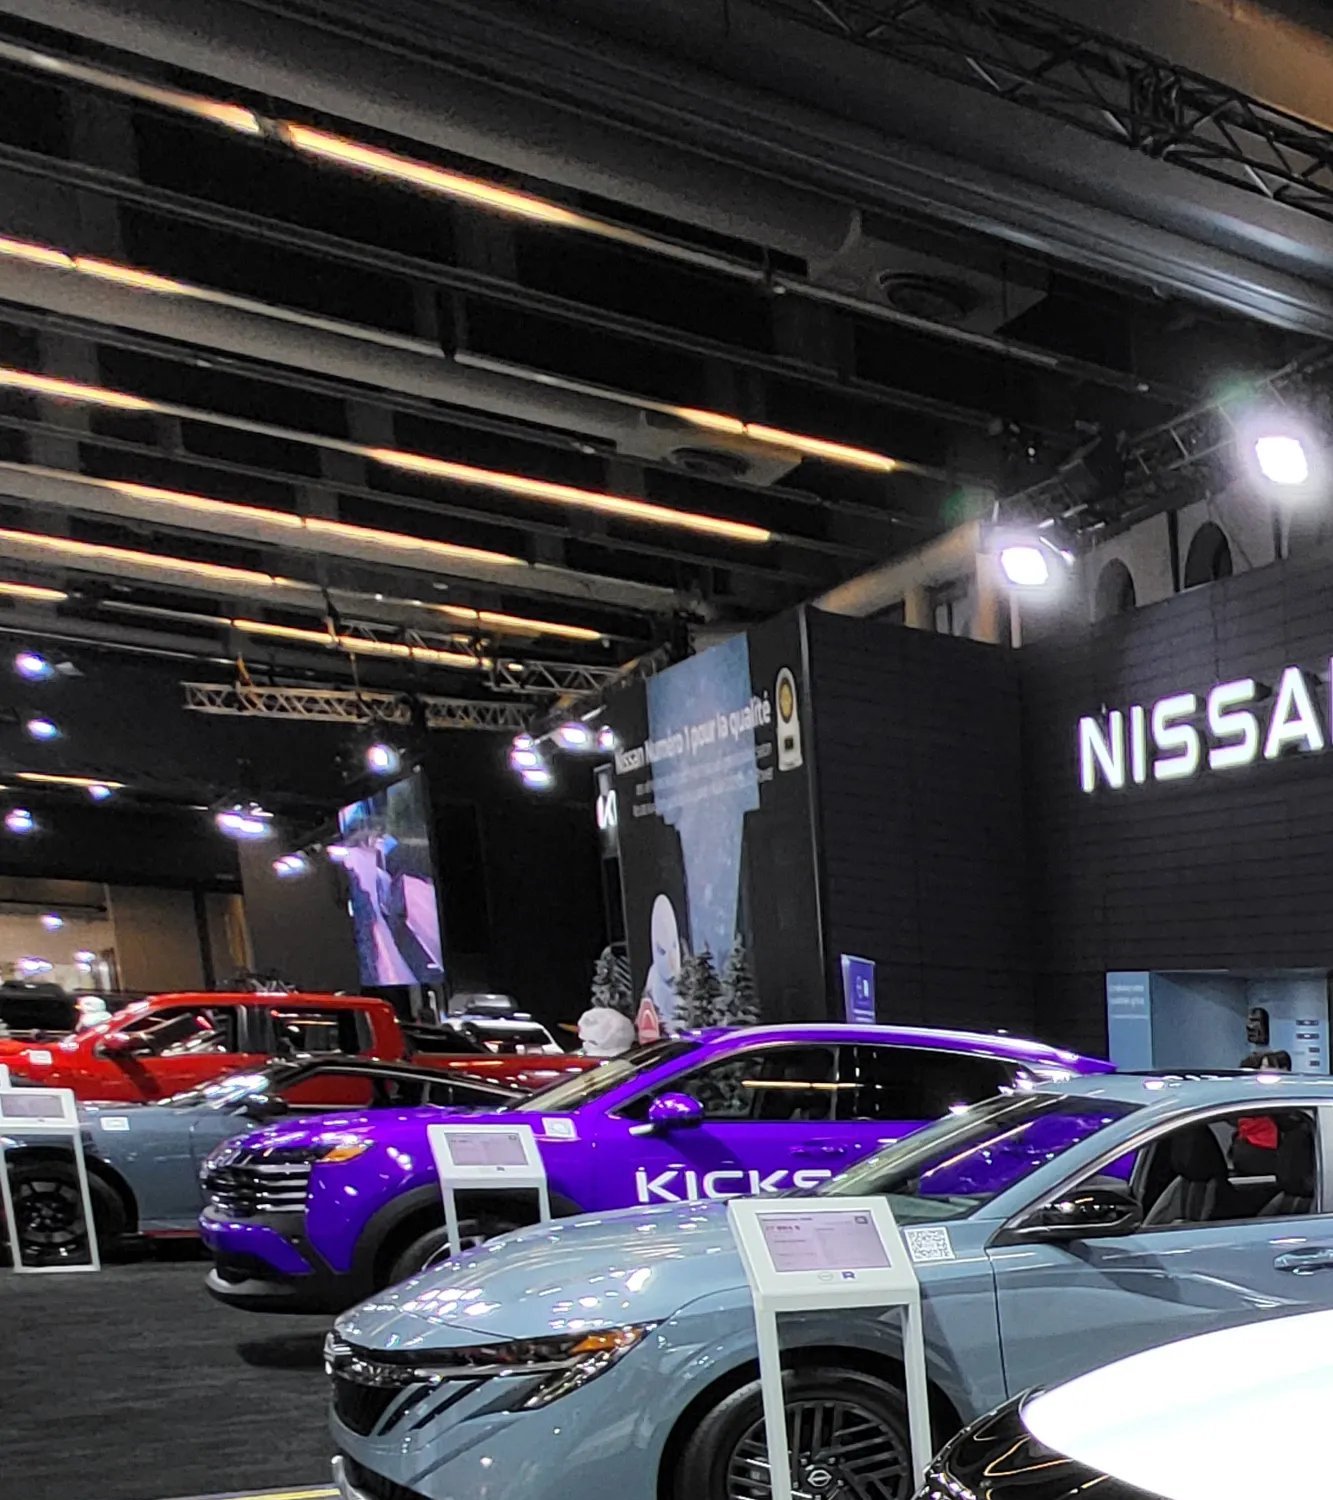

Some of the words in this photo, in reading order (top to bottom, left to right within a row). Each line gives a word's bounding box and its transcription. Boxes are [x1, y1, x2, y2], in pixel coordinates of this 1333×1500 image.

[716, 712, 729, 738] la
[729, 690, 772, 742] qualité
[635, 1169, 832, 1203] KICKS
